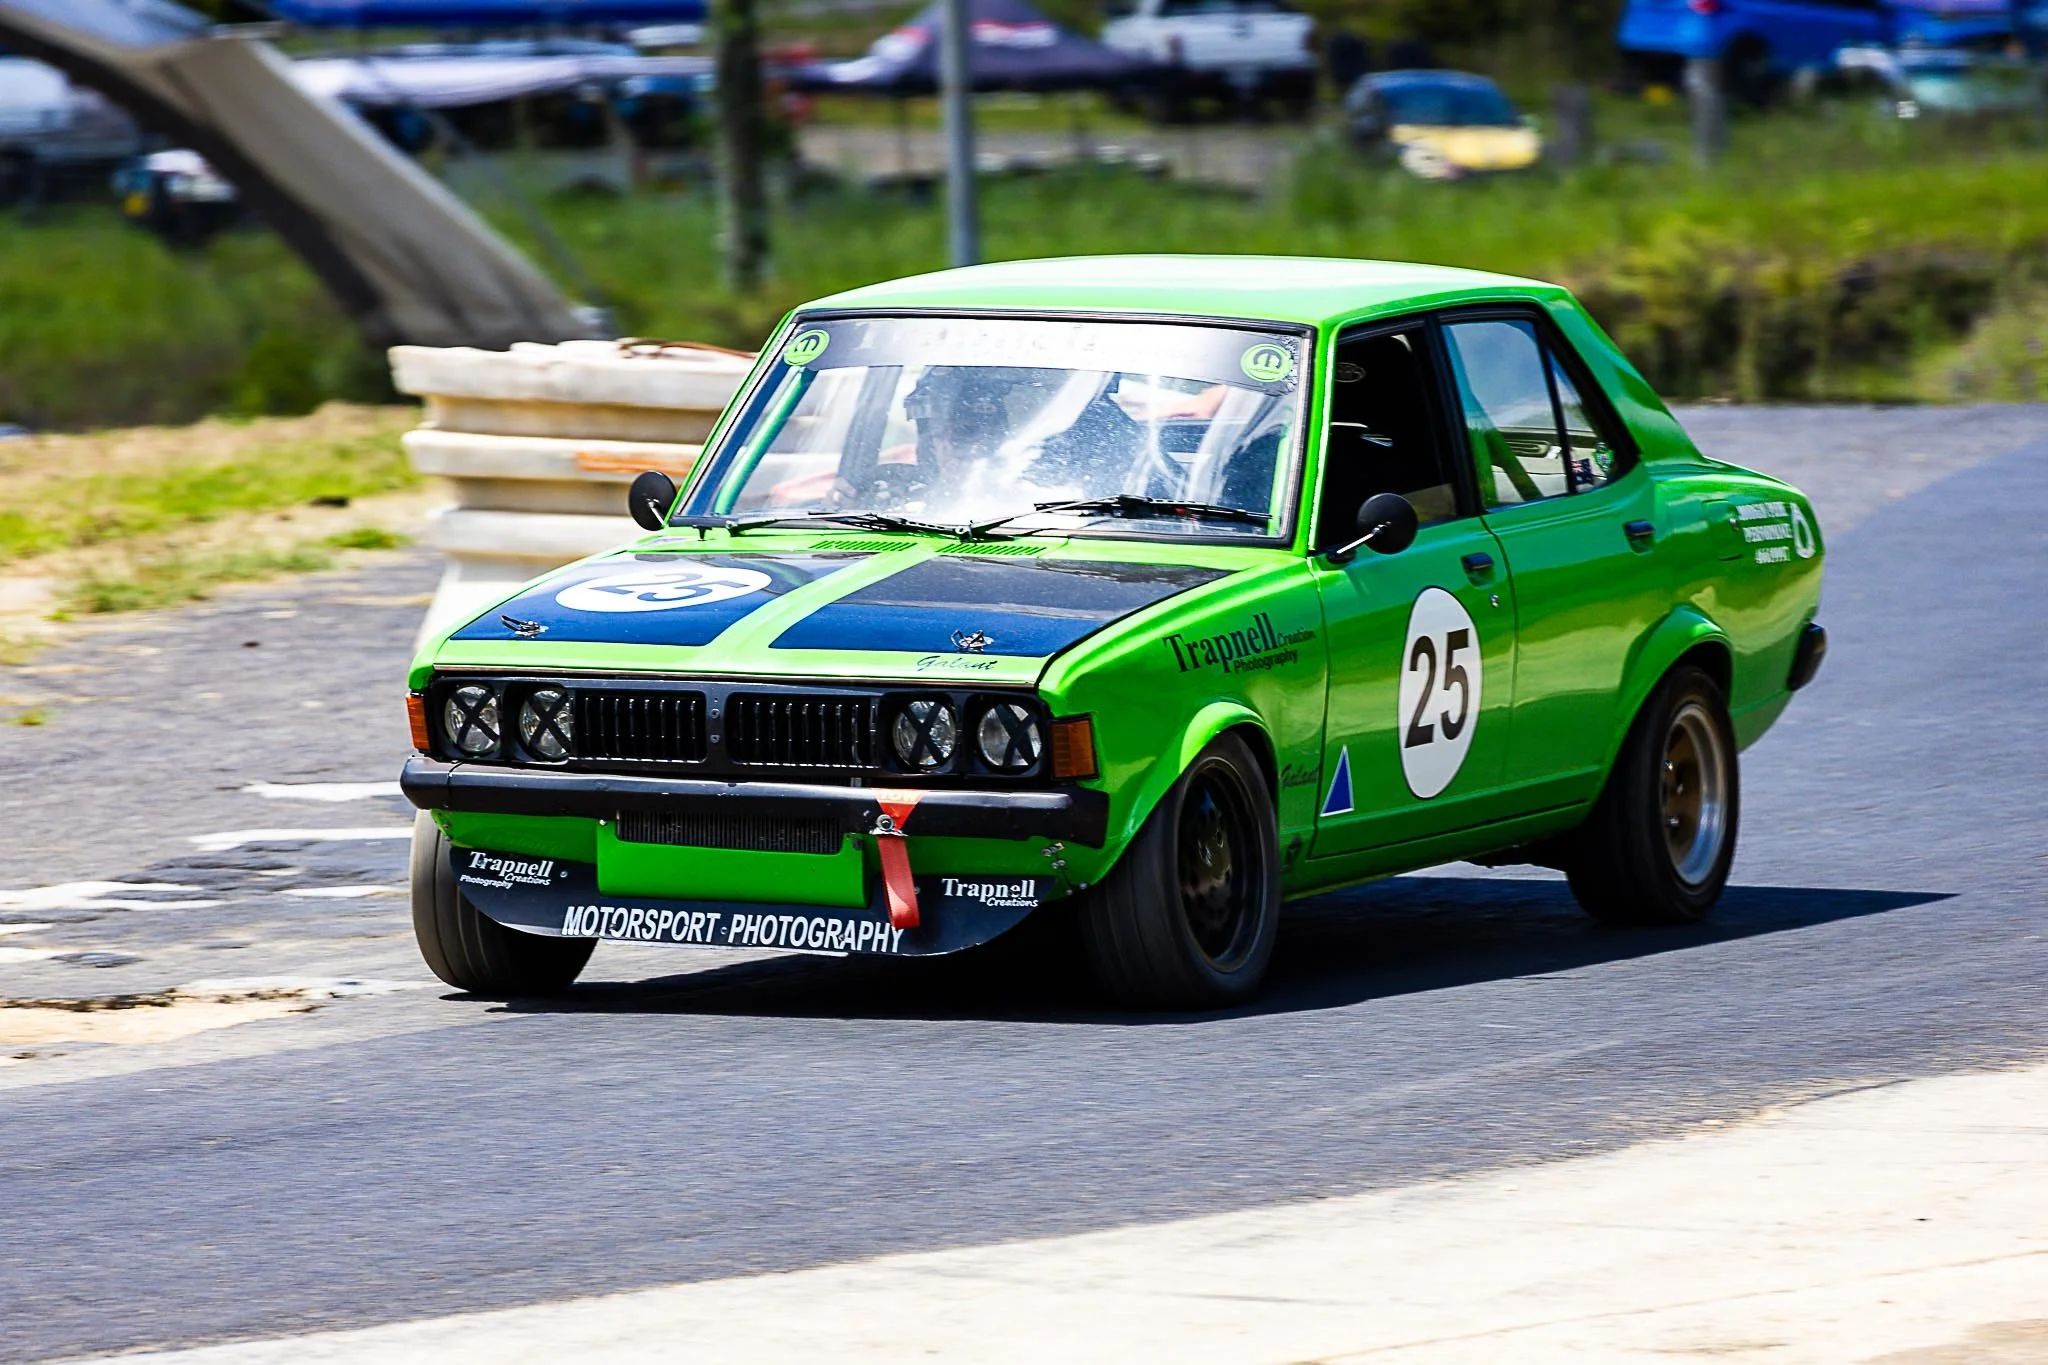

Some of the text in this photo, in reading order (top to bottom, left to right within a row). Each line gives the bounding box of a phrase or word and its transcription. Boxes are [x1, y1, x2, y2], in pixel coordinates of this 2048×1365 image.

[1162, 612, 1278, 673] Trapnell
[1233, 649, 1298, 674] Photography
[1405, 628, 1470, 749] 25
[468, 851, 554, 877] Trapnell
[459, 874, 513, 889] Photography
[504, 872, 551, 886] Creations
[941, 878, 1035, 903] Trapnell
[986, 897, 1039, 907] Creations
[561, 905, 905, 953] MOTORSPORT PHOTOGRAPHY
